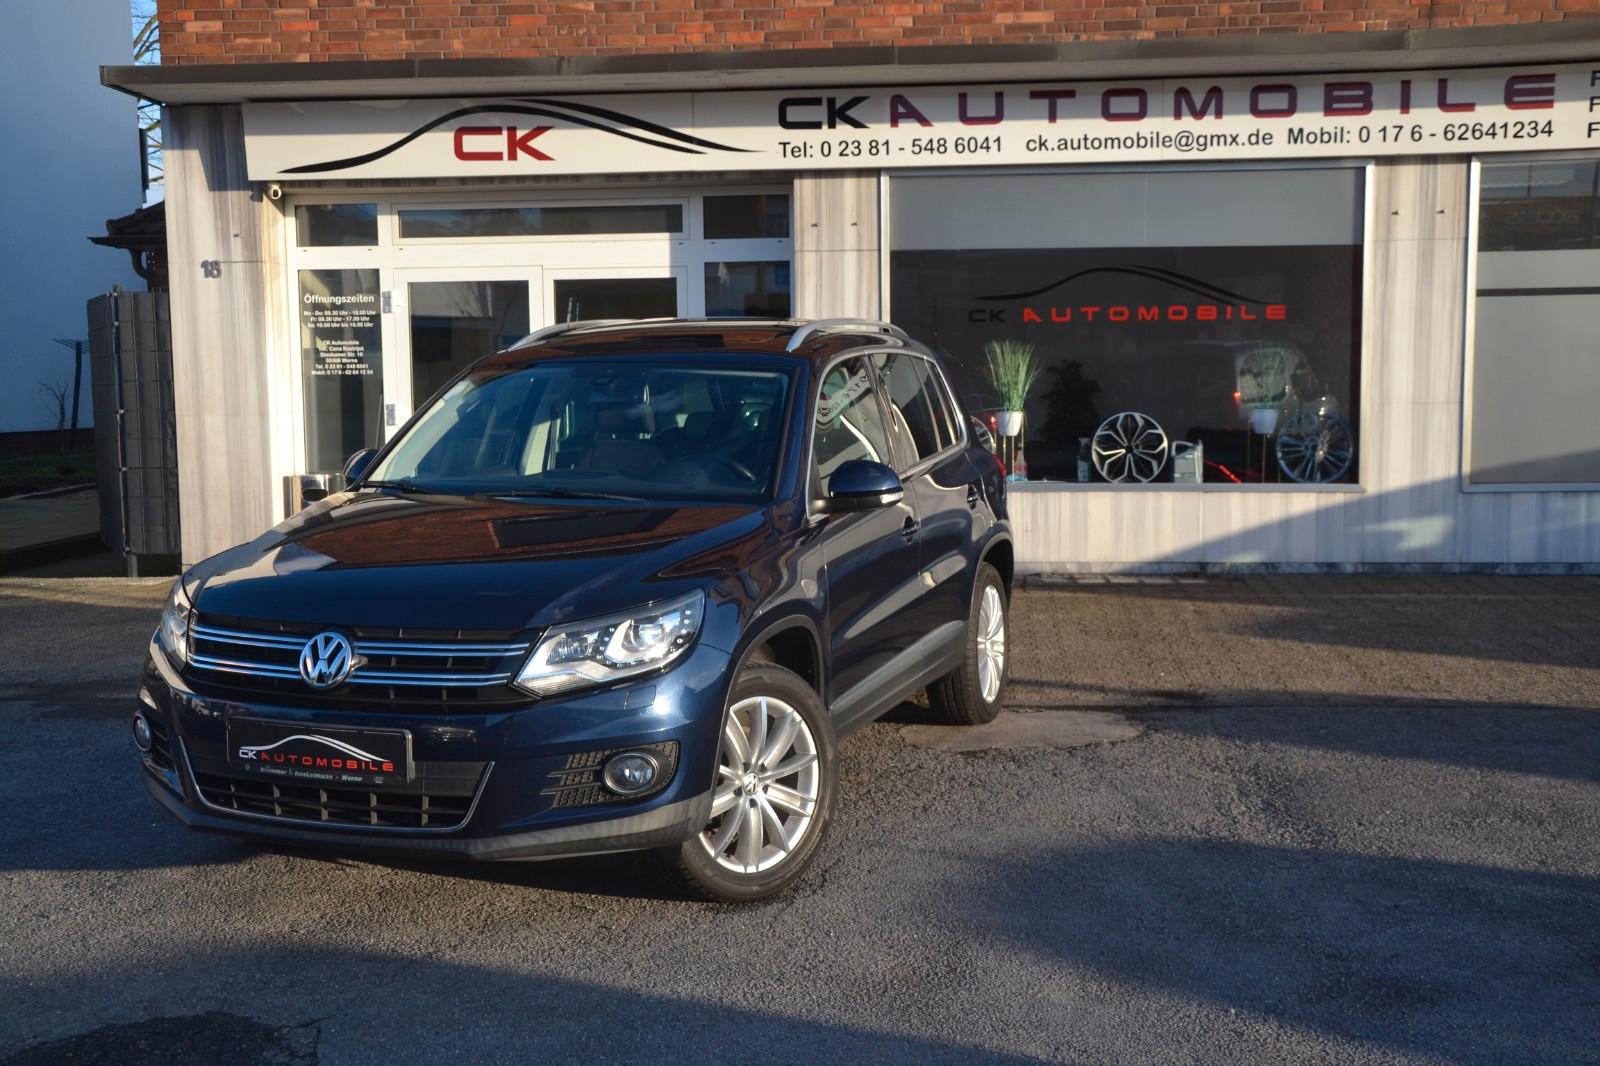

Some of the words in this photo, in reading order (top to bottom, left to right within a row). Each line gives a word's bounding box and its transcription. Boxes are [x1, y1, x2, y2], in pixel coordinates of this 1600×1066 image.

[778, 96, 870, 129] CK
[889, 73, 1556, 128] AUTOMOBILE
[454, 126, 556, 161] CK
[778, 141, 813, 158] Tel:
[911, 137, 948, 155] 548
[954, 136, 1002, 154] 6041
[1026, 128, 1273, 153] ck.automobile@gmx.de
[1287, 126, 1351, 144] Mobil:
[1443, 119, 1554, 141] 62641234
[201, 260, 222, 278] 18
[304, 293, 375, 305] Öffnungszeiten
[968, 309, 1006, 323] CK
[1023, 304, 1286, 323] AUTOMOBILE
[239, 749, 257, 760] CK
[260, 751, 394, 771] AUTOMOBILE
